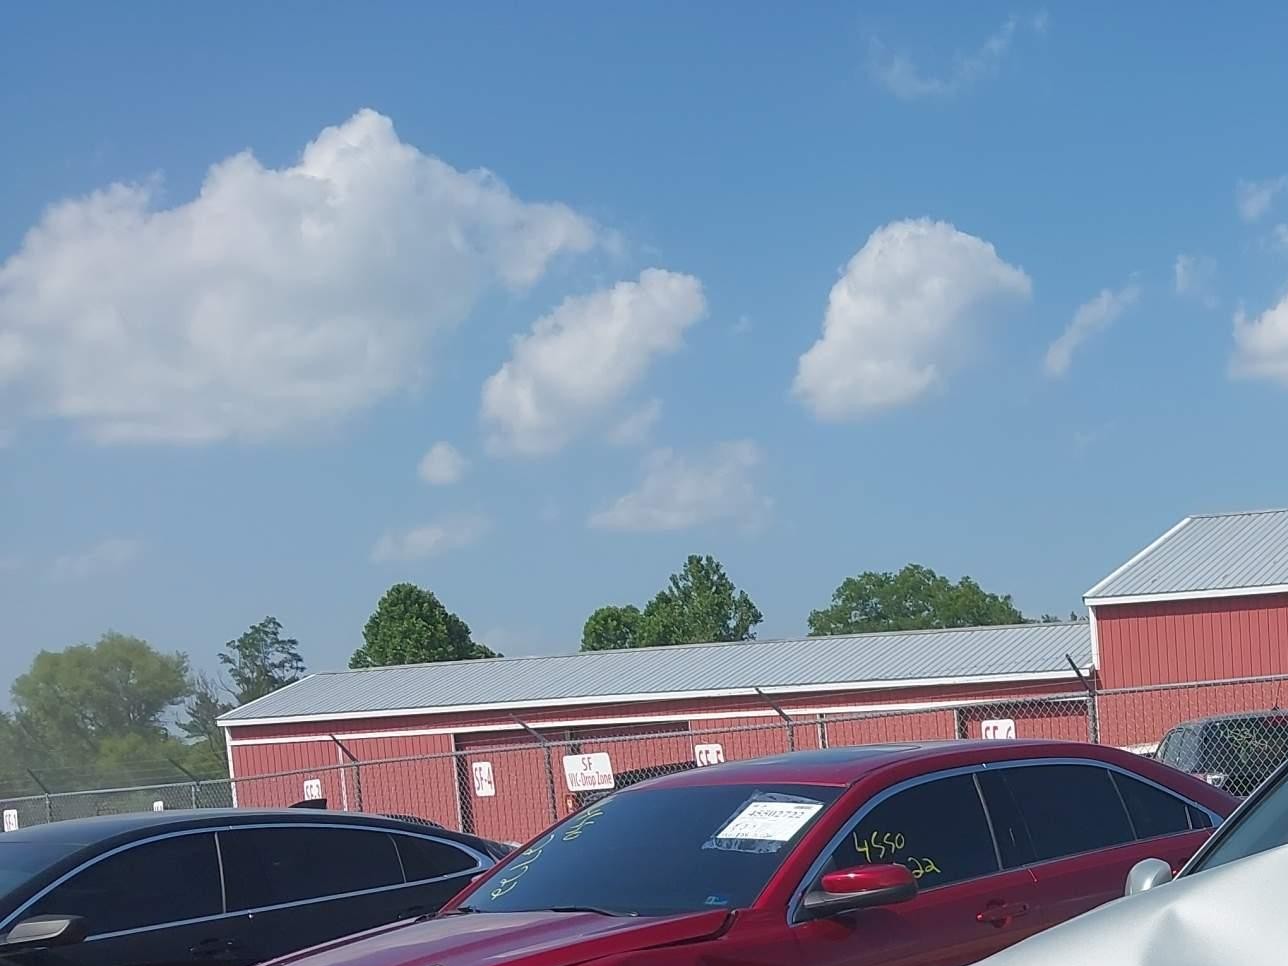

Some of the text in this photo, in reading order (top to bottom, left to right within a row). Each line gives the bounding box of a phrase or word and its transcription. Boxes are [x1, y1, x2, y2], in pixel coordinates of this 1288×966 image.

[581, 756, 592, 771] SF
[474, 766, 493, 791] SF-4
[596, 770, 612, 786] Zone
[853, 831, 905, 863] 4550
